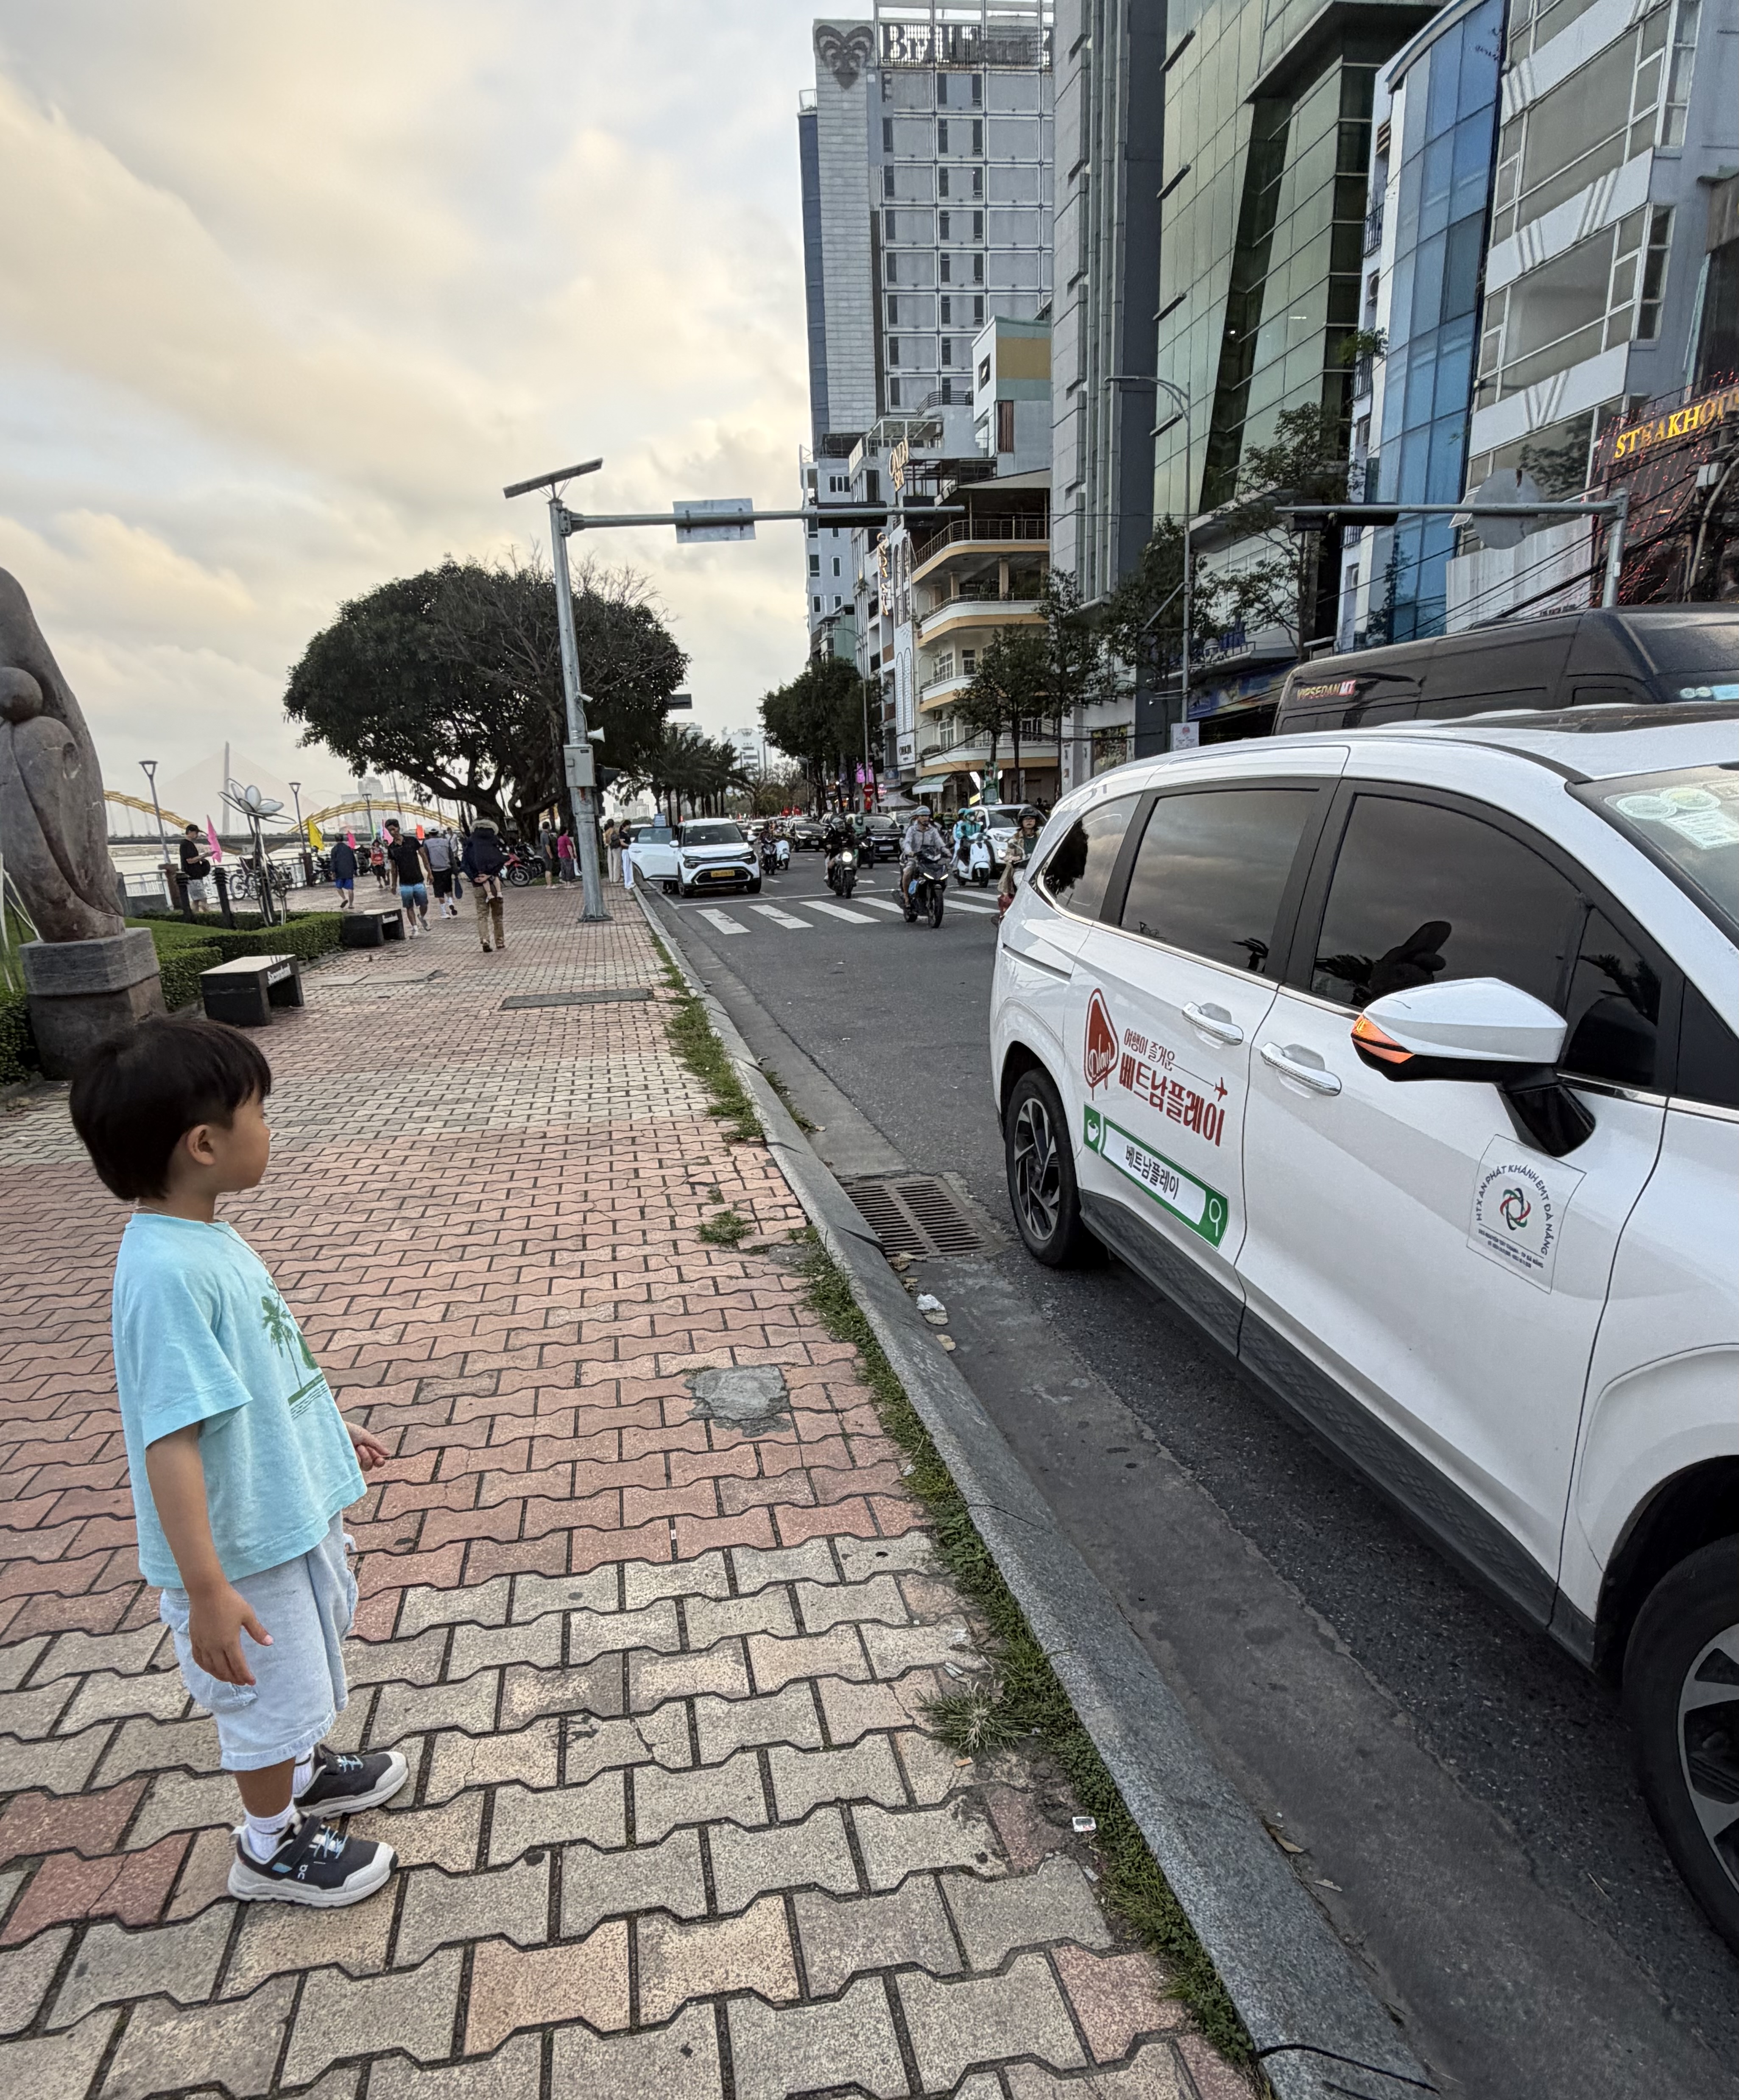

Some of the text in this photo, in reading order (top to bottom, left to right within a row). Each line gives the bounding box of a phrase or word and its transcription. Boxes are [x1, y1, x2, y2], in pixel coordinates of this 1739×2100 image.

[1124, 1028, 1175, 1072] 여행이 즐거운
[1119, 1052, 1225, 1147] 베트남플레이
[1125, 1145, 1179, 1201] 베트남플레이
[1479, 1182, 1488, 1199] AN
